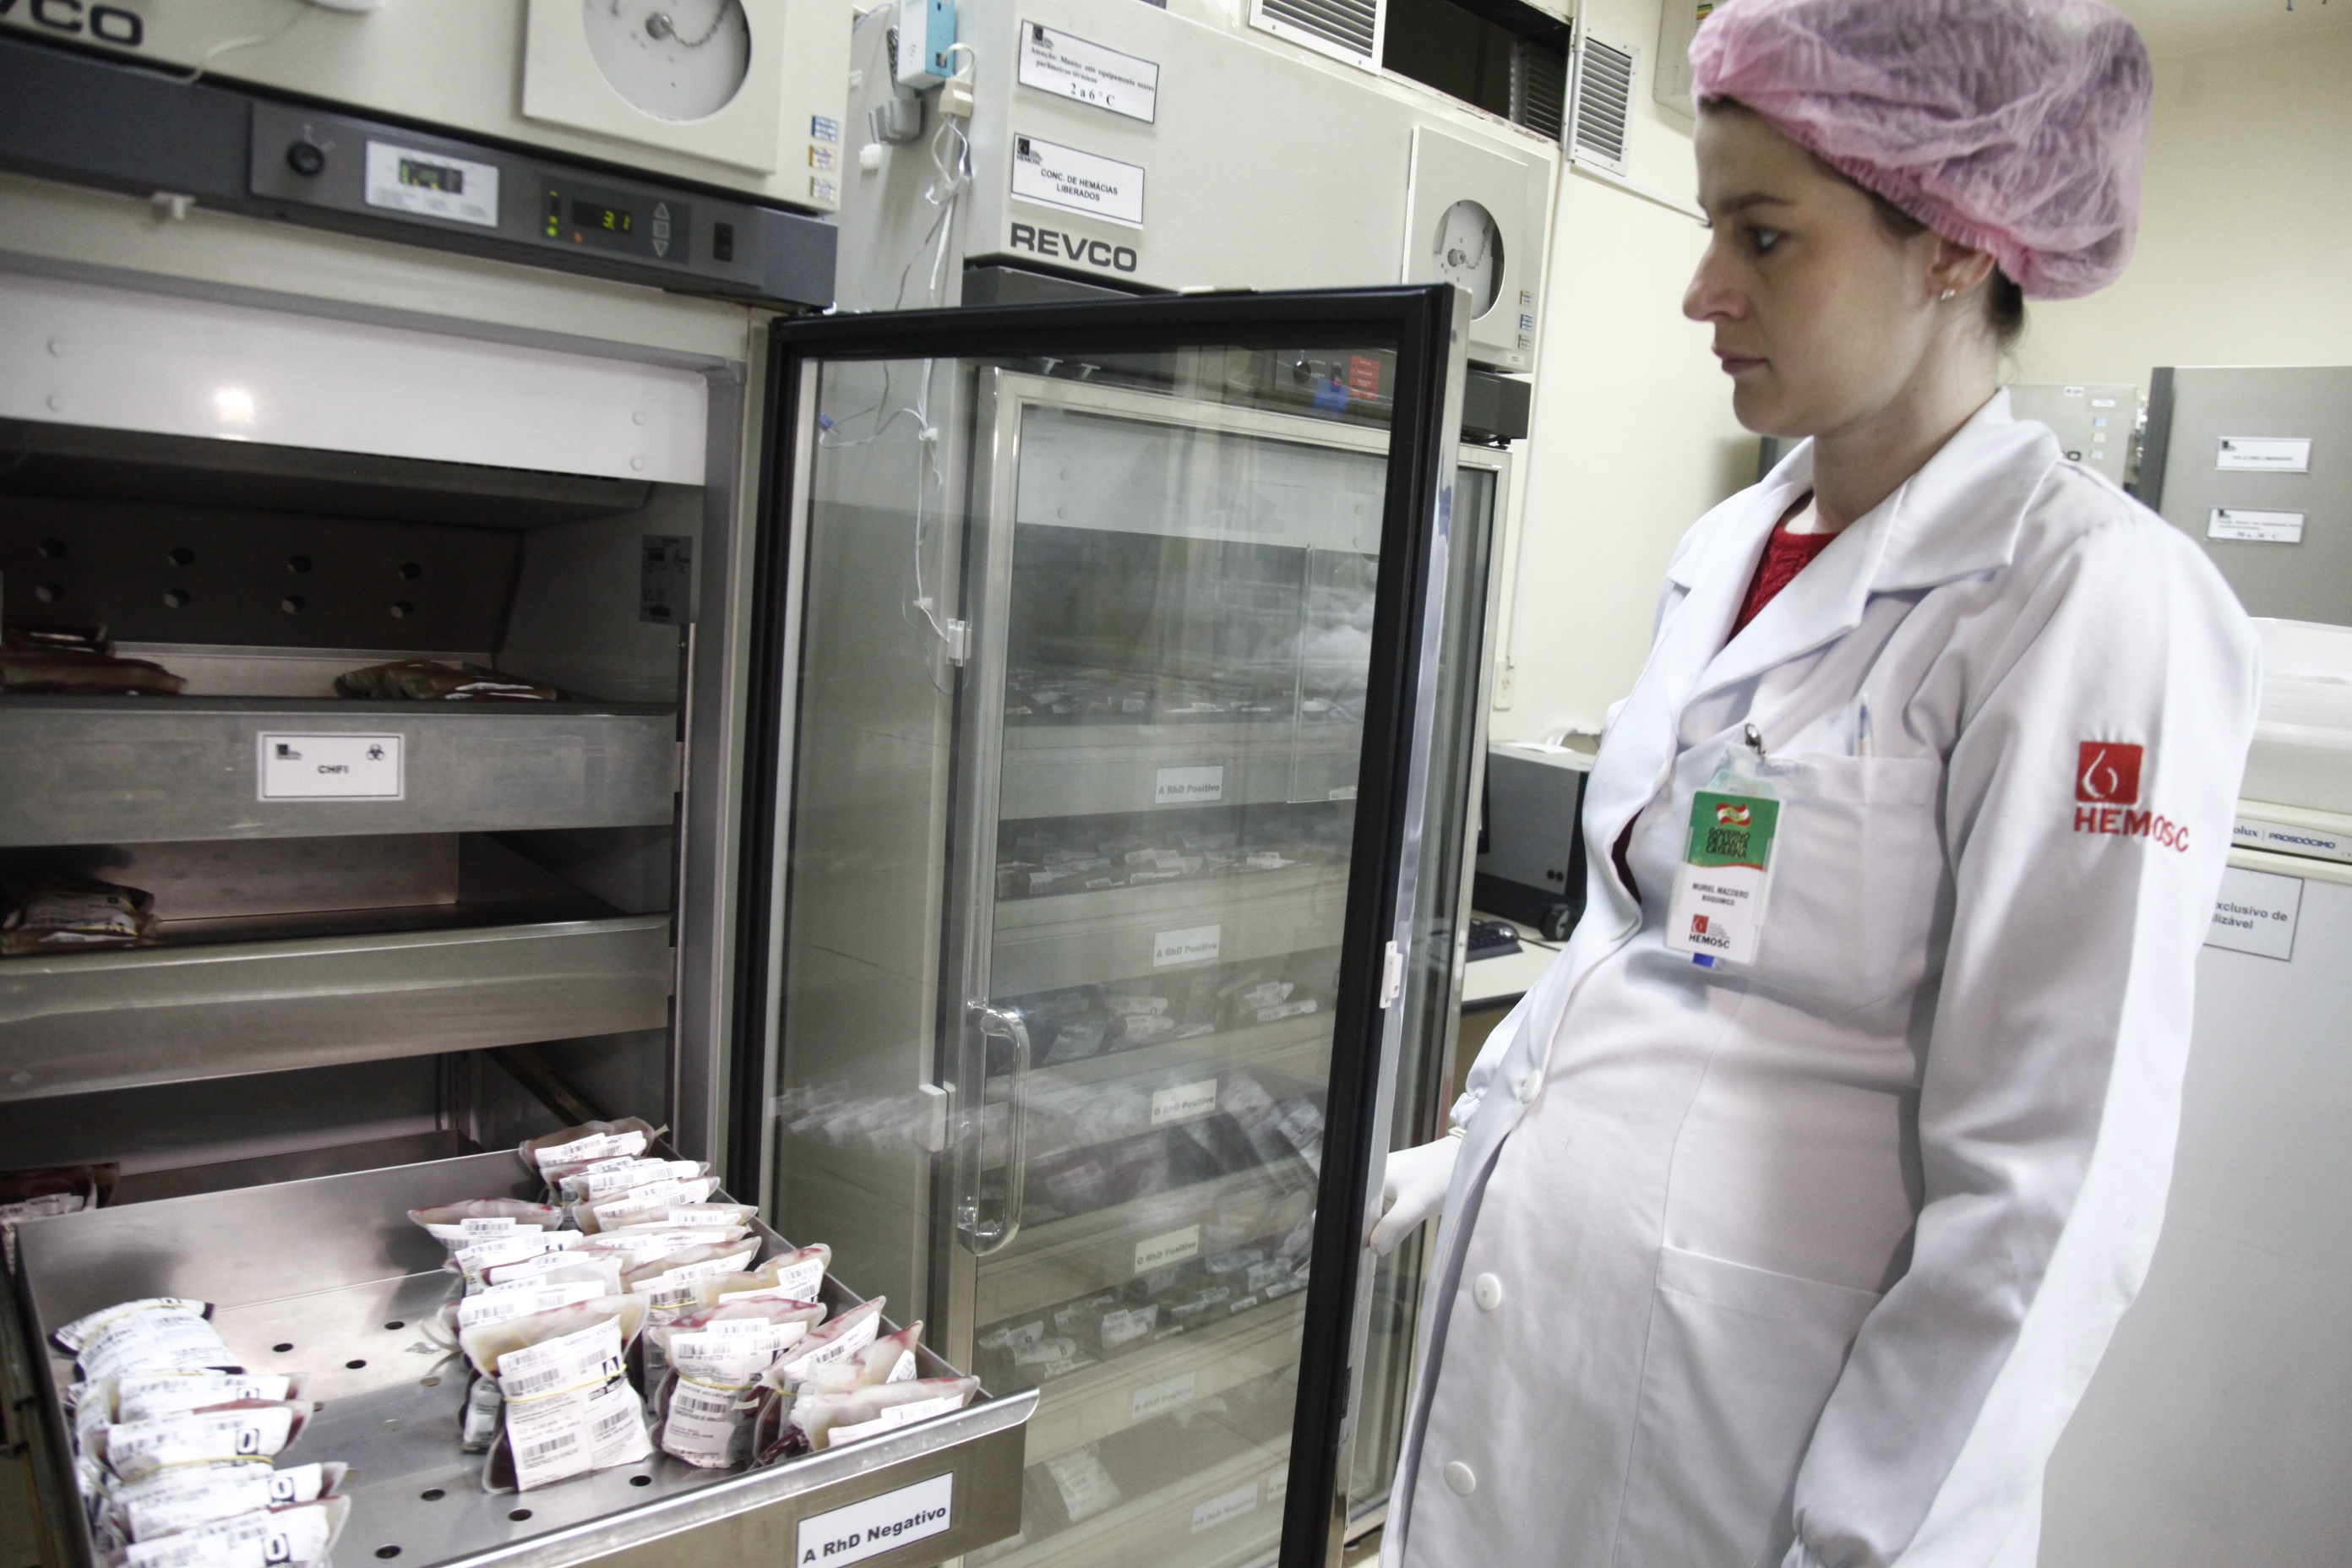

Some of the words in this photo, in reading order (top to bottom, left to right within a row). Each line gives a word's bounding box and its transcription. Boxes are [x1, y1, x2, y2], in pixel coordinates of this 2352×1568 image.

[1060, 55, 1082, 70] Manter
[1070, 82, 1077, 95] 2
[1089, 89, 1096, 101] 6
[1041, 168, 1065, 182] CONC.
[1067, 175, 1077, 185] DE
[1080, 177, 1119, 195] HEMÁCIAS
[1056, 183, 1101, 201] LIBERADOS
[1010, 221, 1137, 273] REVCO
[1158, 786, 1165, 795] A
[1167, 785, 1184, 794] RhD
[1187, 783, 1220, 793] Positivo
[1708, 827, 1750, 841] GOVERNO
[2073, 807, 2189, 852] HEMOSC
[1705, 844, 1747, 858] CATARINA
[1692, 882, 1715, 893] MURIEL
[2272, 910, 2288, 922] de
[1689, 933, 1730, 950] HEMOSC
[1156, 949, 1163, 958] A
[1165, 946, 1183, 957] RhD
[1184, 942, 1217, 954] Positivo
[803, 1549, 816, 1564] A
[823, 1533, 860, 1557] RhD
[867, 1506, 947, 1543] Negativo
